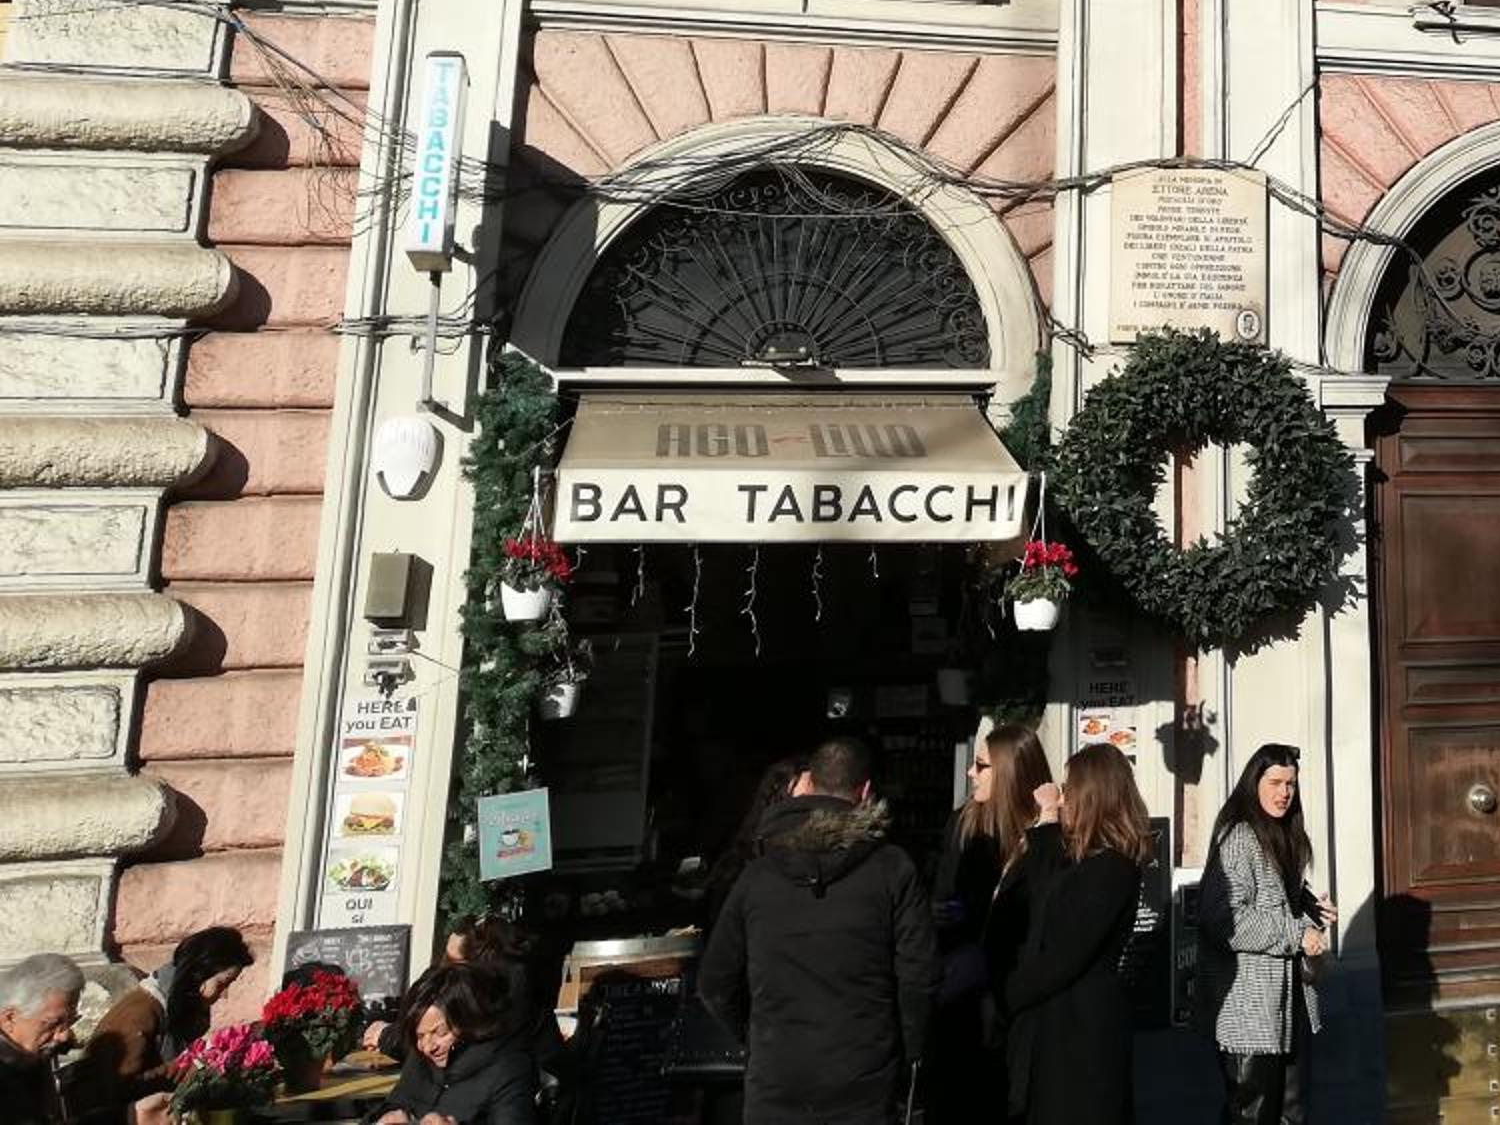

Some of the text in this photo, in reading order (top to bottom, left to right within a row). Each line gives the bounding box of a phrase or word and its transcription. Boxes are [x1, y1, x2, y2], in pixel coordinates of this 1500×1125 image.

[417, 62, 455, 244] TABACCHI
[1151, 184, 1229, 197] ETTORE ARENA
[656, 424, 770, 458] AGO
[569, 482, 1017, 524] BAR TABACCHI
[357, 700, 406, 715] HERE
[345, 715, 413, 733] you EAT
[345, 897, 374, 912] QUI
